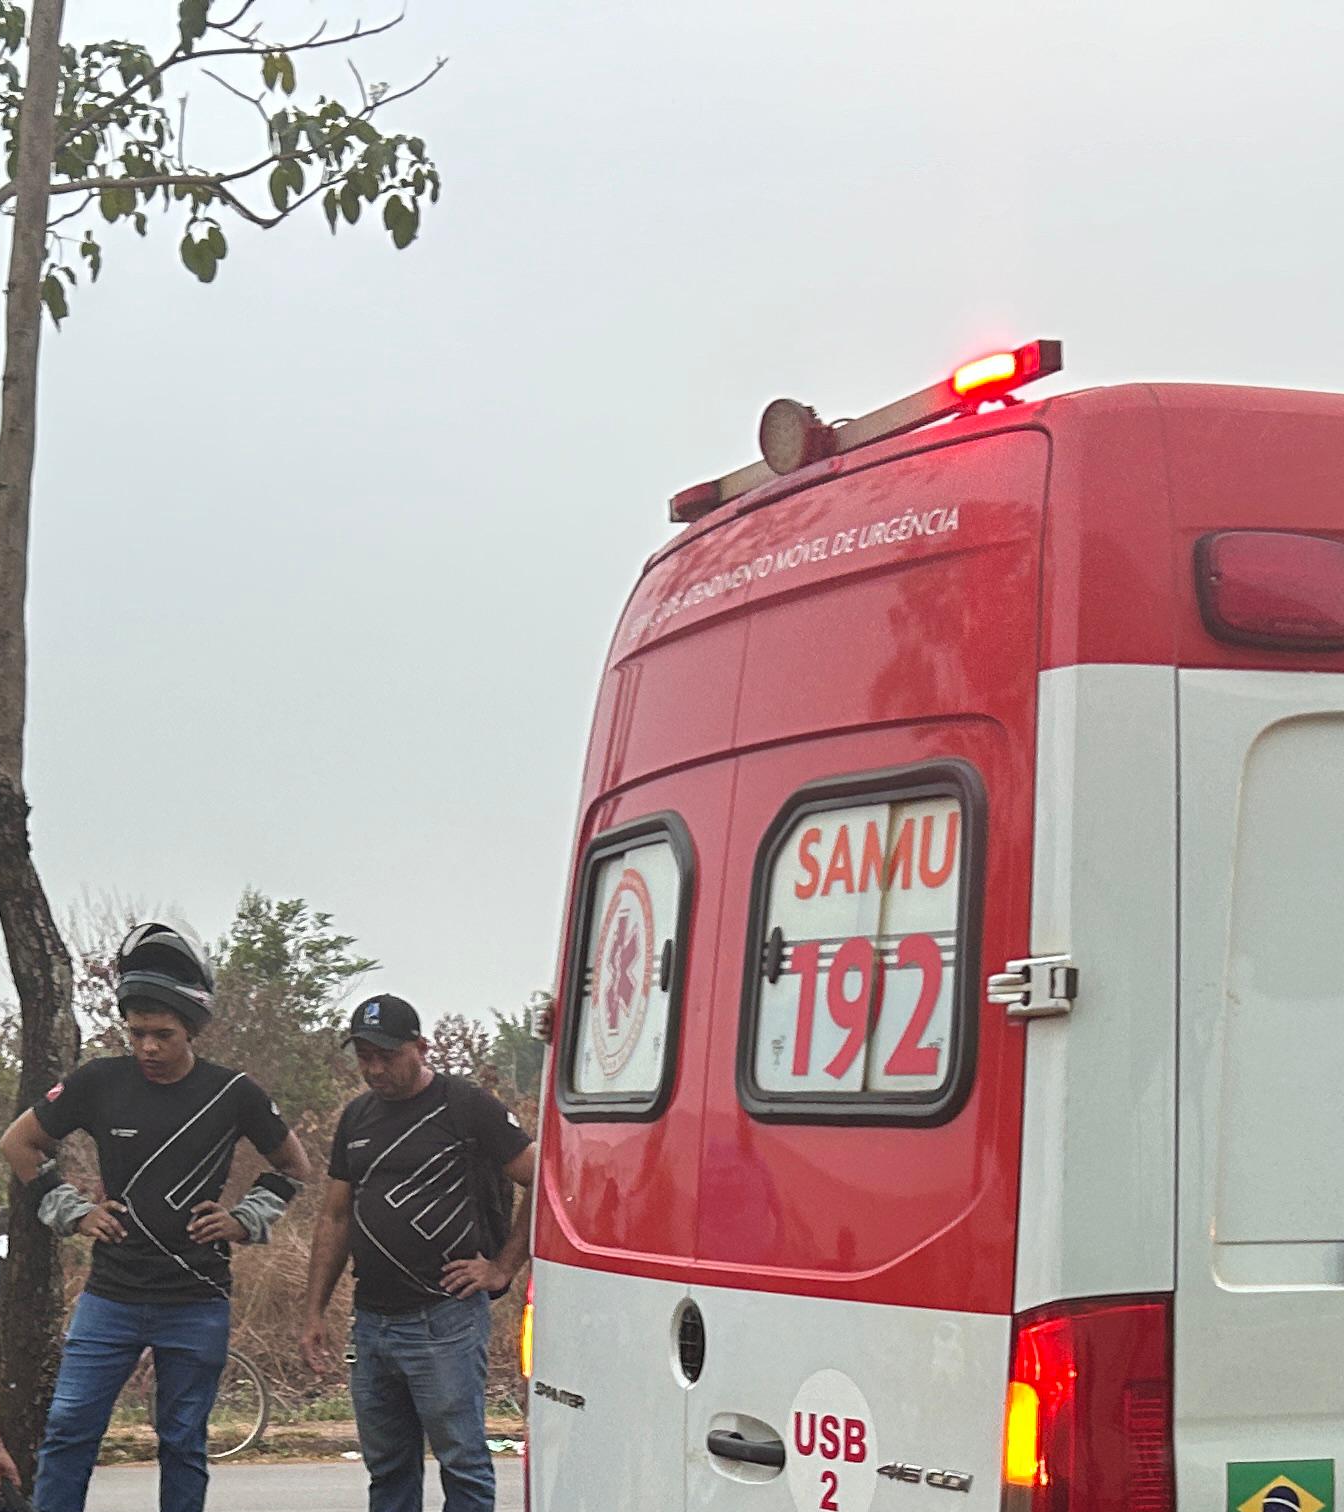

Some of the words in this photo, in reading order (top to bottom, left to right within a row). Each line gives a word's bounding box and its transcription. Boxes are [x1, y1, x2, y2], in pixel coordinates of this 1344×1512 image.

[777, 537, 829, 573] MÓVEL
[831, 531, 855, 555] DE
[858, 504, 960, 547] URGÊNCIA
[794, 812, 960, 900] SAMU
[791, 932, 943, 1080] 192
[793, 1411, 867, 1464] USB
[819, 1470, 840, 1512] 2
